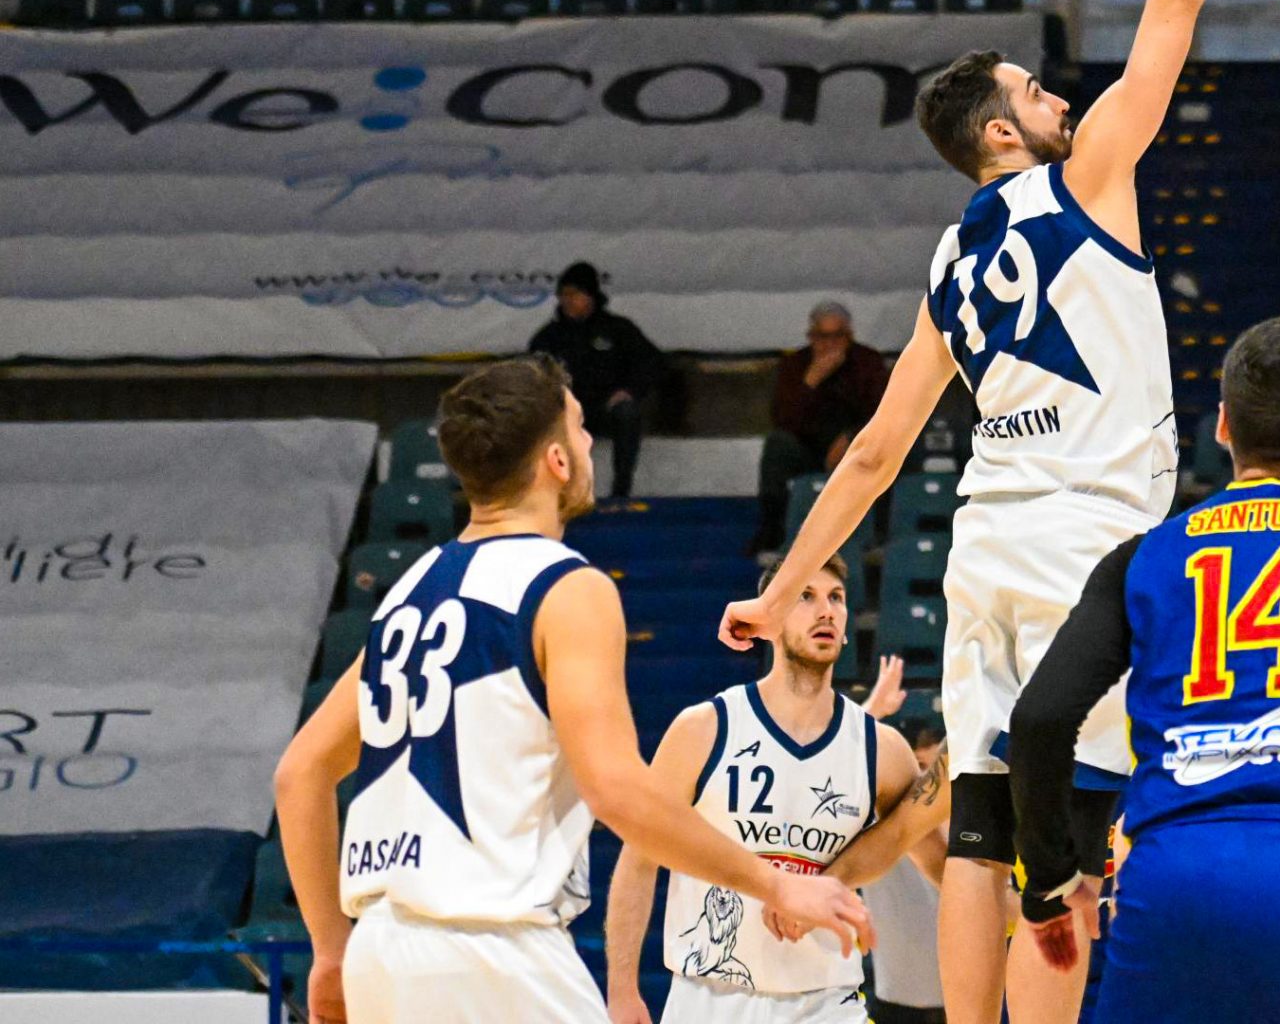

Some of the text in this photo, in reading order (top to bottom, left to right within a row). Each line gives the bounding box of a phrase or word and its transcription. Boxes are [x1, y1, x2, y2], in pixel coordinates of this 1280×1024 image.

[953, 229, 1038, 355] 19
[358, 598, 466, 748] 33
[726, 765, 775, 814] 12
